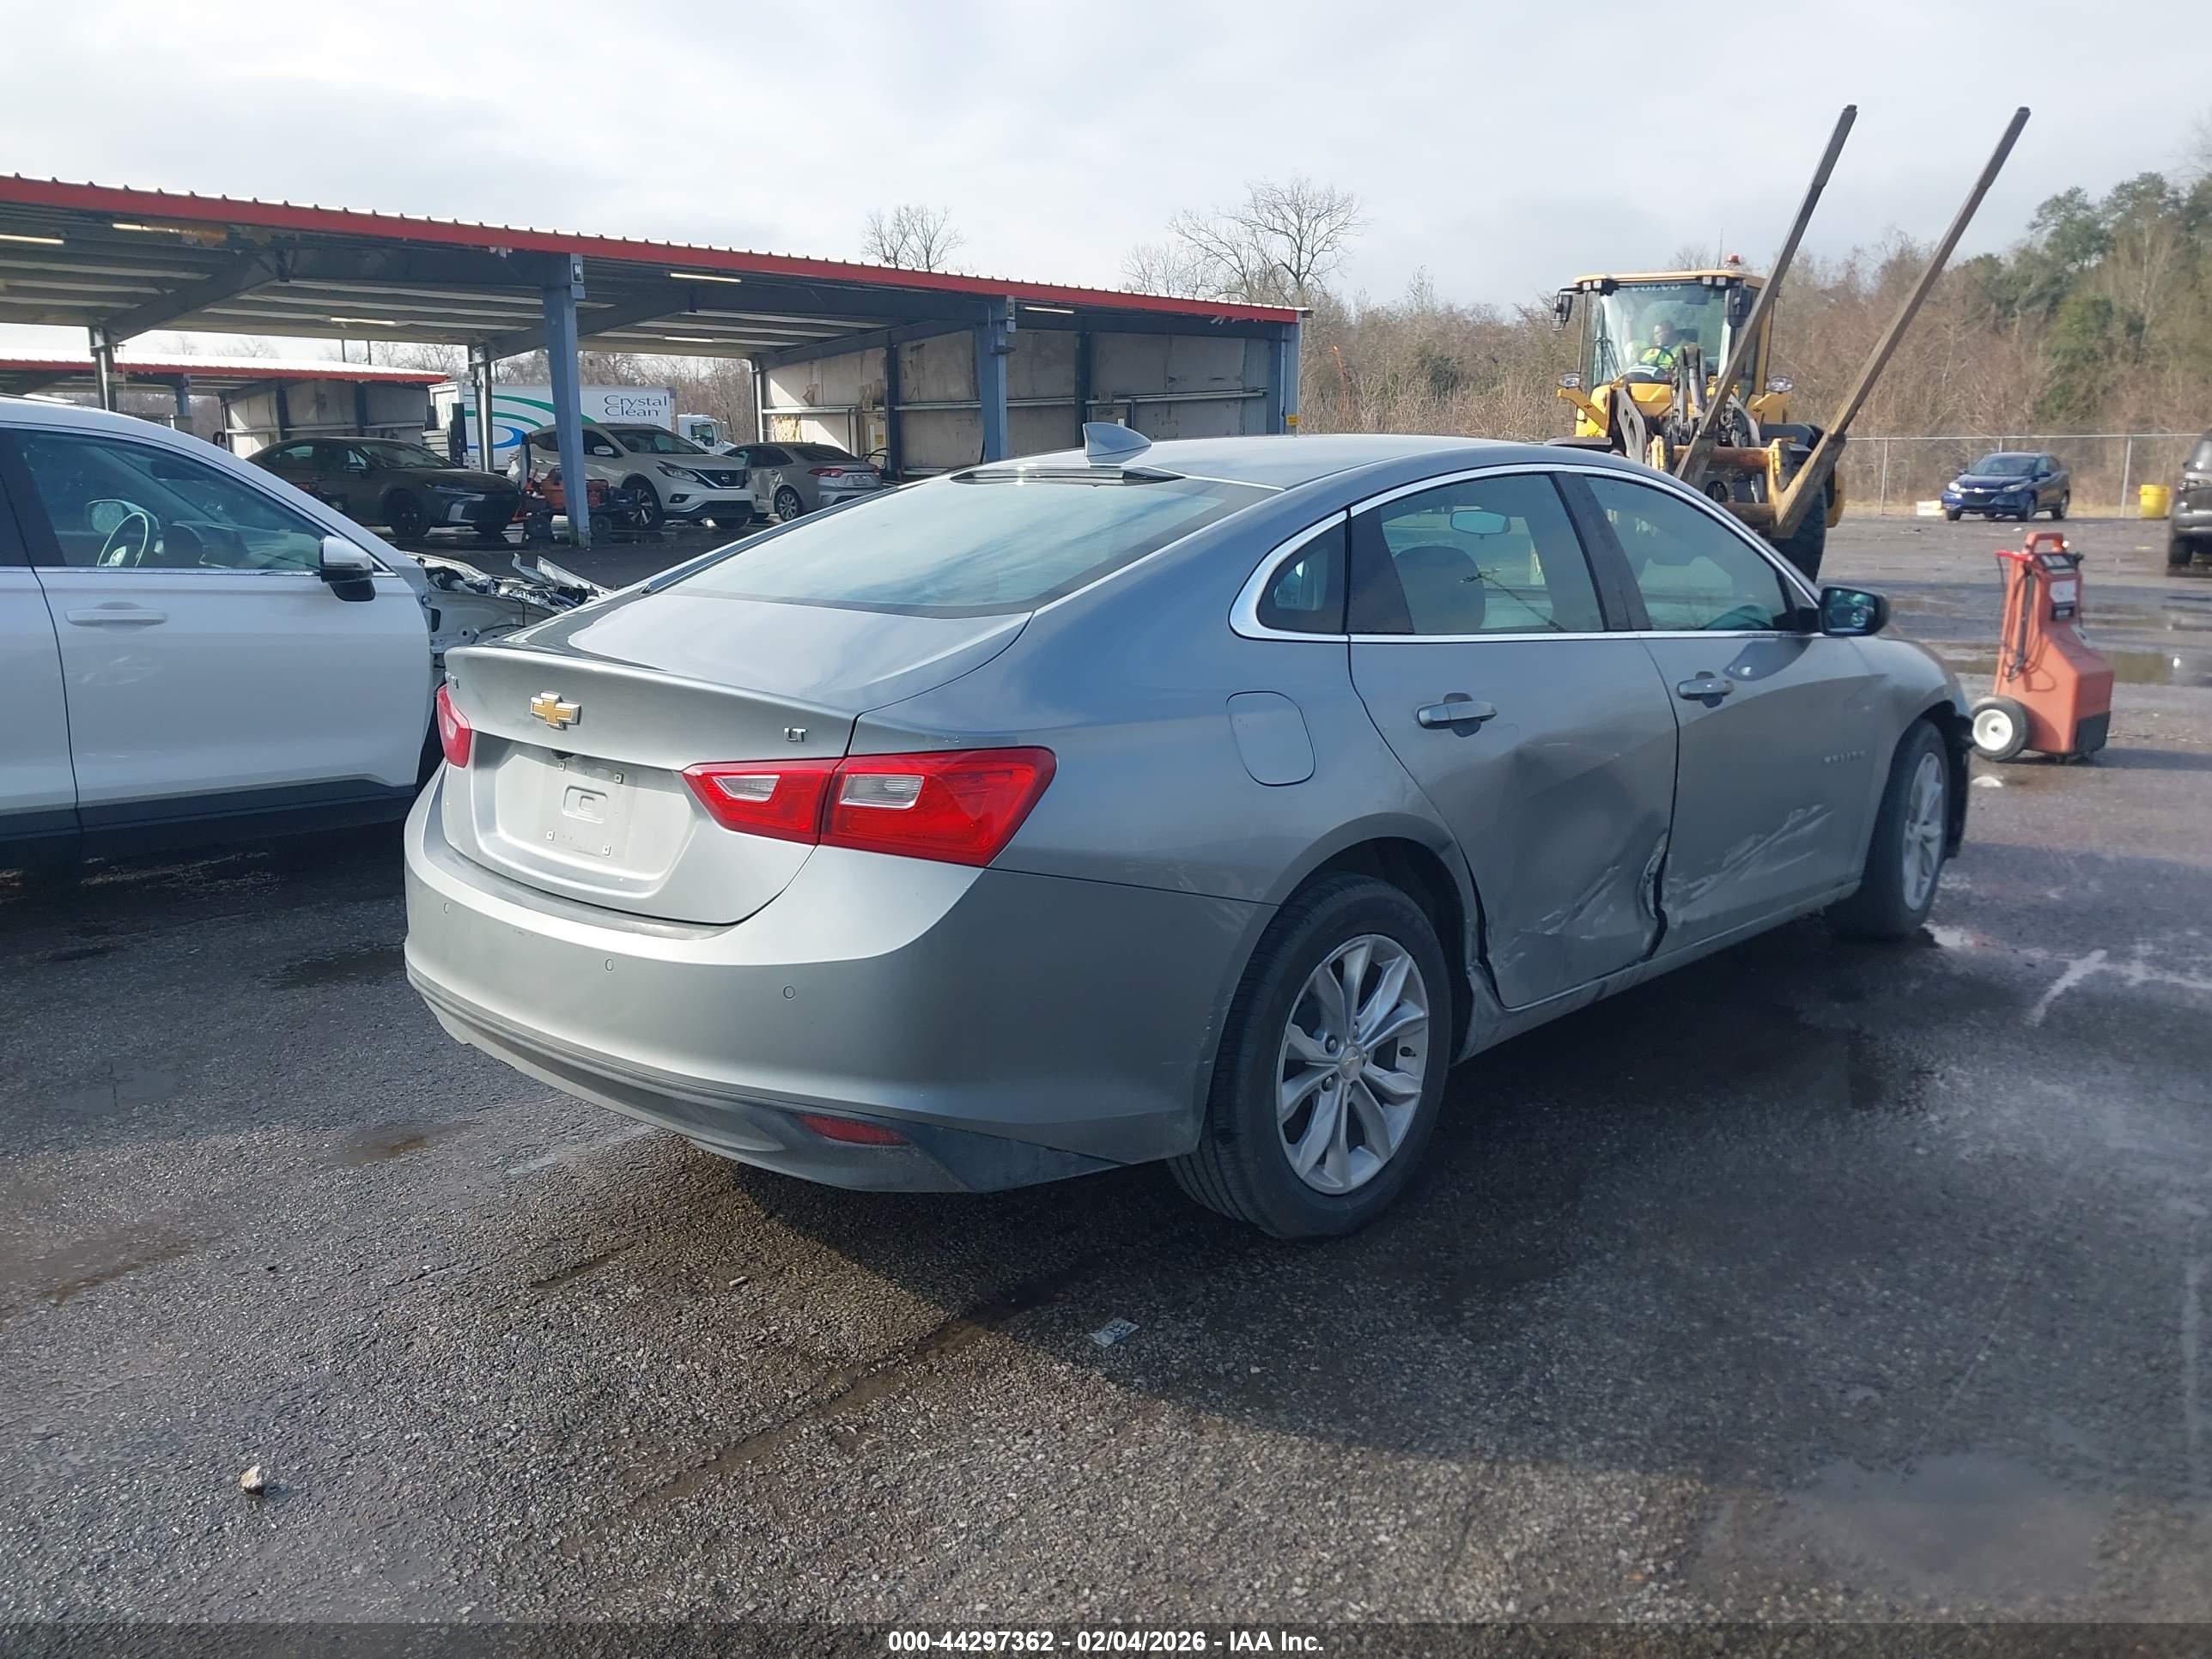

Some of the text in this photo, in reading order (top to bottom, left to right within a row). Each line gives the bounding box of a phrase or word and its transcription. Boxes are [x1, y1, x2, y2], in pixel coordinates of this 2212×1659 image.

[604, 394, 667, 409] Crystal
[605, 405, 659, 417] Clean
[784, 727, 806, 743] LT
